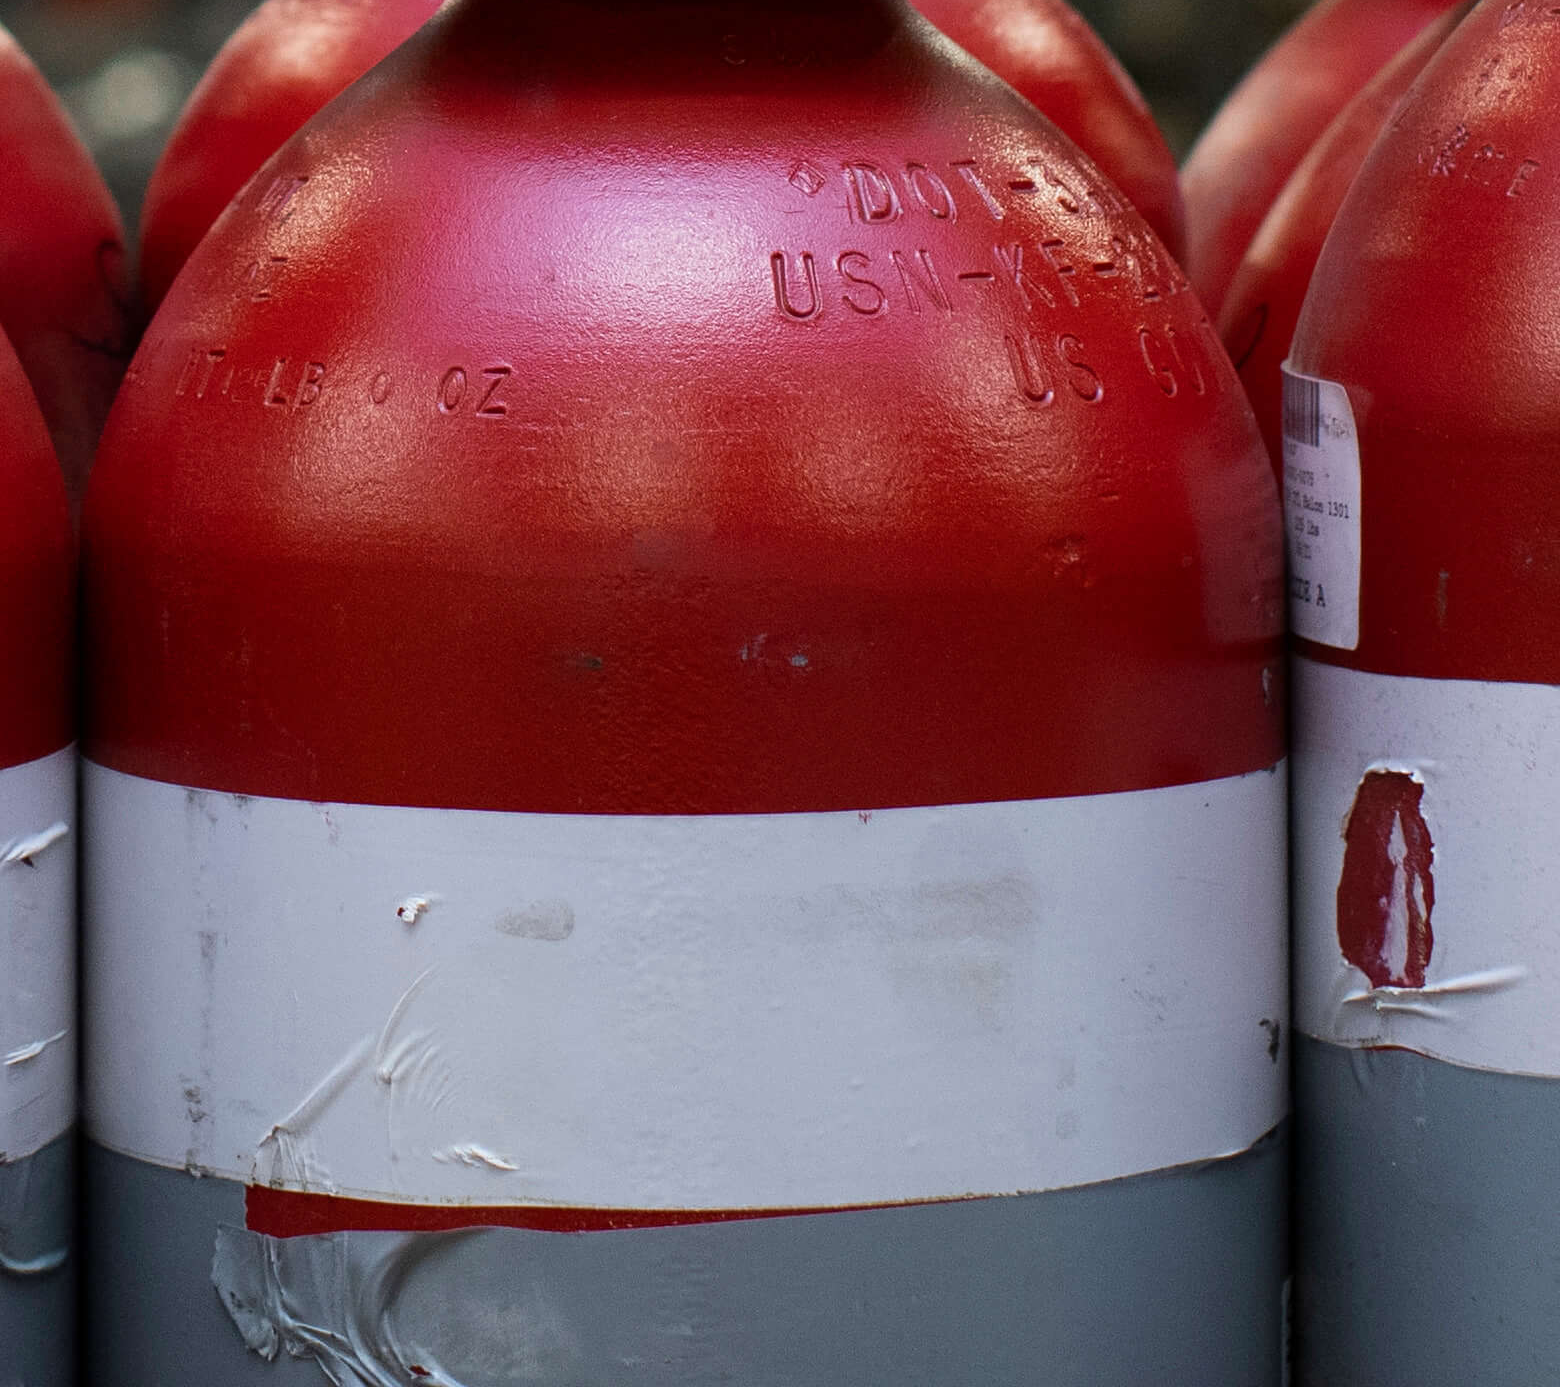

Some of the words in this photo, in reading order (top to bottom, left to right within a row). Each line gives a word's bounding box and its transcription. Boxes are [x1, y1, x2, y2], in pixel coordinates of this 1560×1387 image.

[263, 357, 326, 410] LB
[437, 361, 513, 420] OZ
[1004, 329, 1105, 408] US
[1327, 500, 1350, 520] 1301
